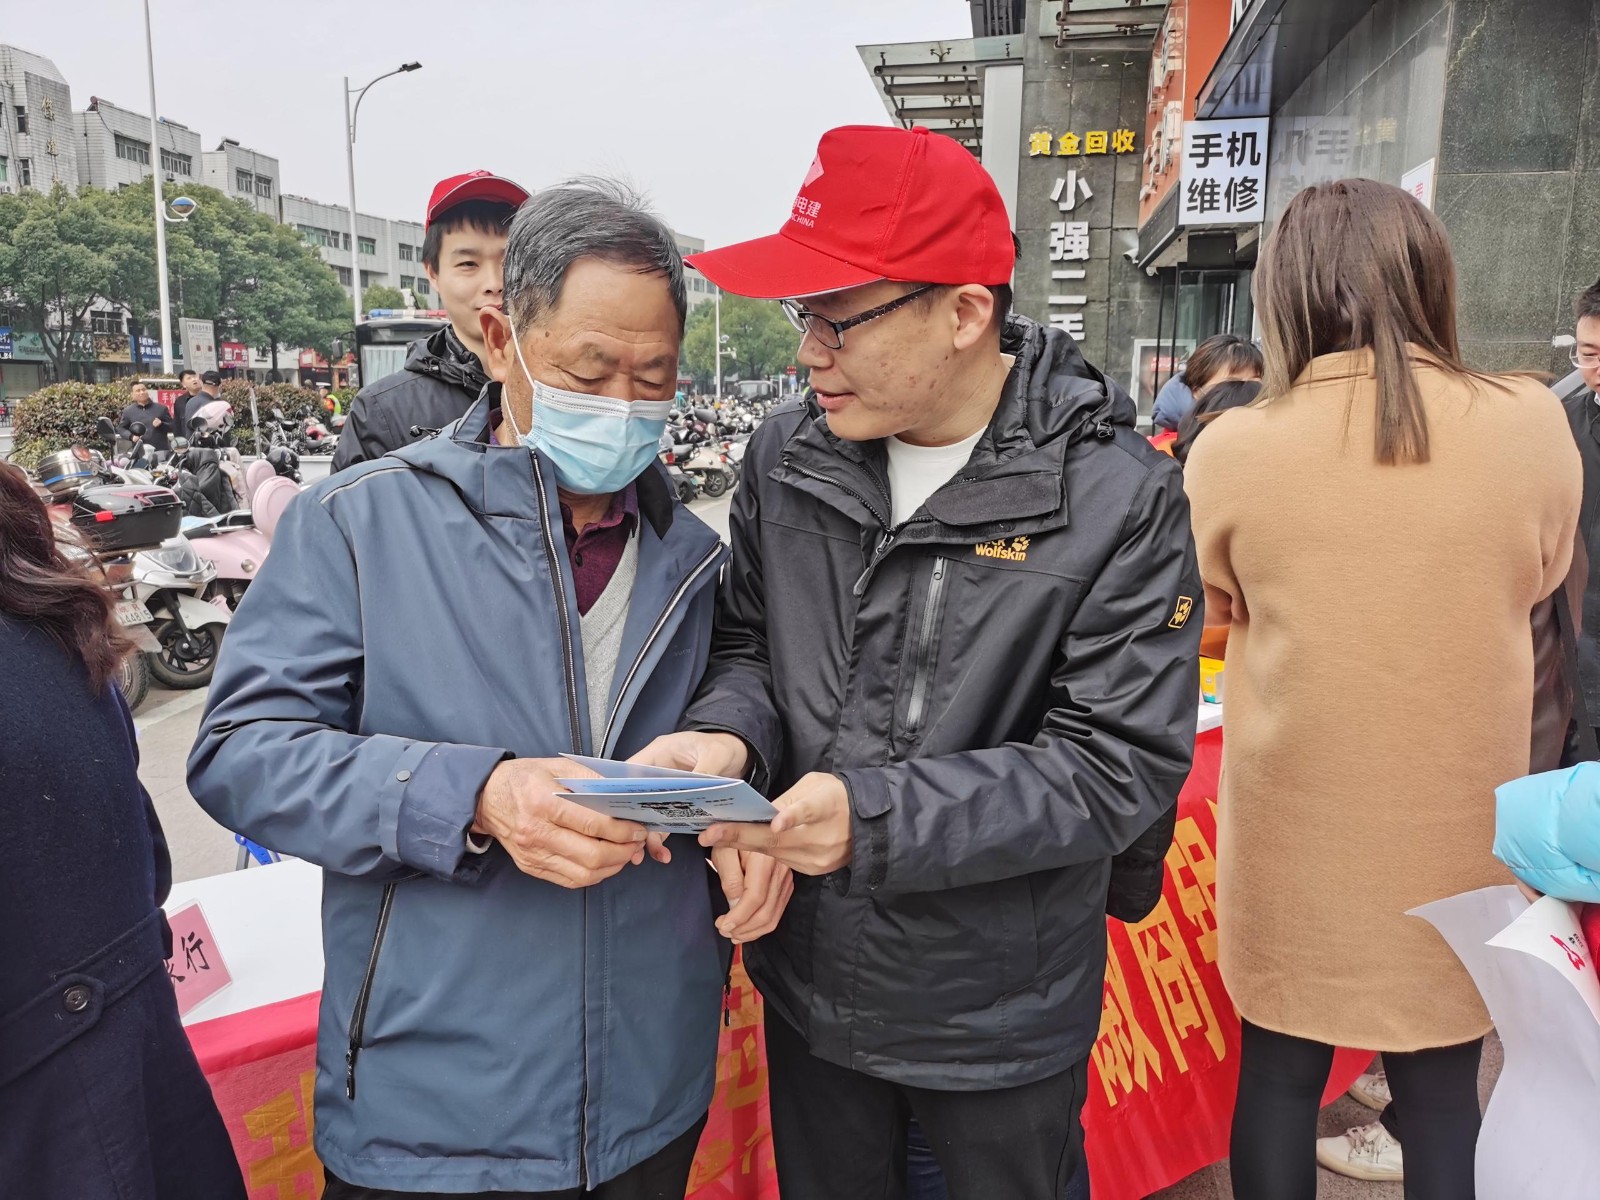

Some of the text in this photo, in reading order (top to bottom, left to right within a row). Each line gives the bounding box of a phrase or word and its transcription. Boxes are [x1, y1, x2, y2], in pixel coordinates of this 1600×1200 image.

[1029, 128, 1136, 157] 黄金回收
[1188, 131, 1262, 168] 手机
[792, 196, 822, 218] 电建
[1186, 176, 1259, 214] 维修
[975, 543, 1027, 562] Wolfskin
